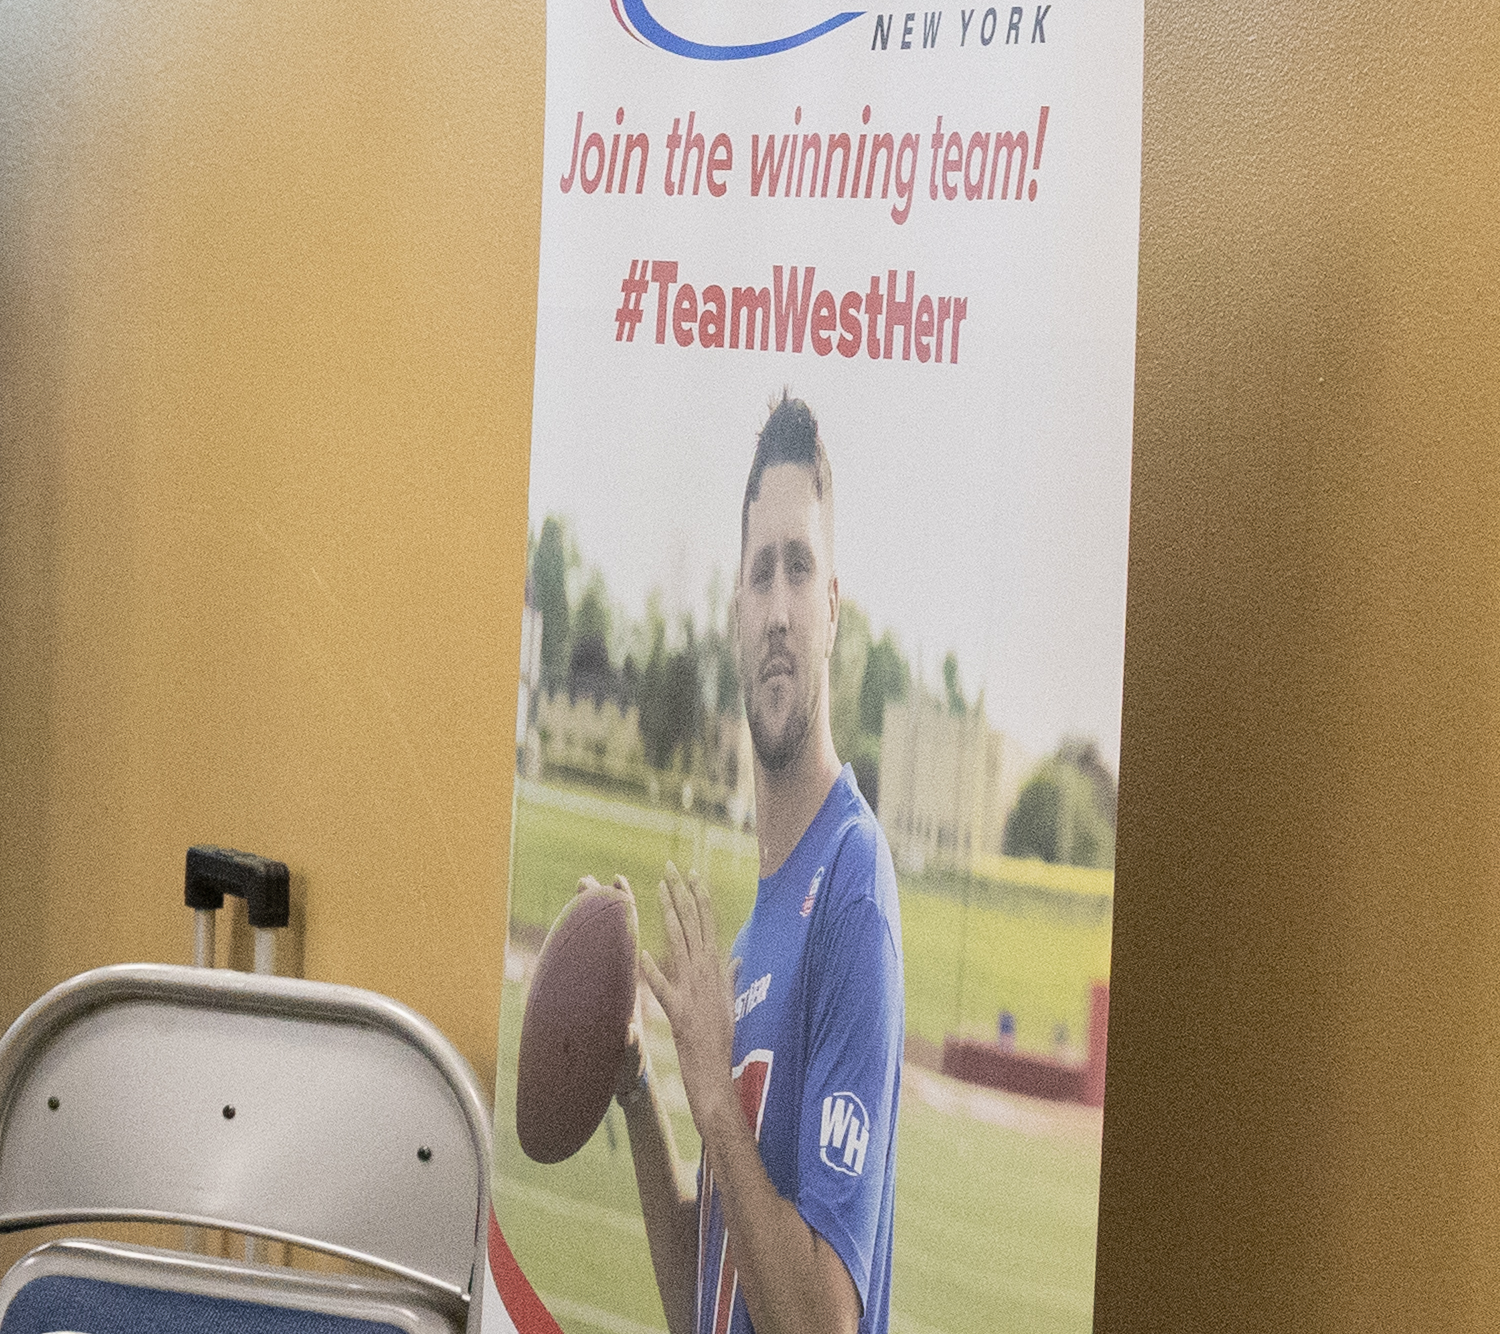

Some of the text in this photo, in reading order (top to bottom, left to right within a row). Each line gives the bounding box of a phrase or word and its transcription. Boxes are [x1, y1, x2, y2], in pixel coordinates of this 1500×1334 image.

[871, 4, 1052, 51] NEW YORK
[559, 104, 1051, 226] Join the winning team!
[614, 258, 968, 366] #TeamWestHerr
